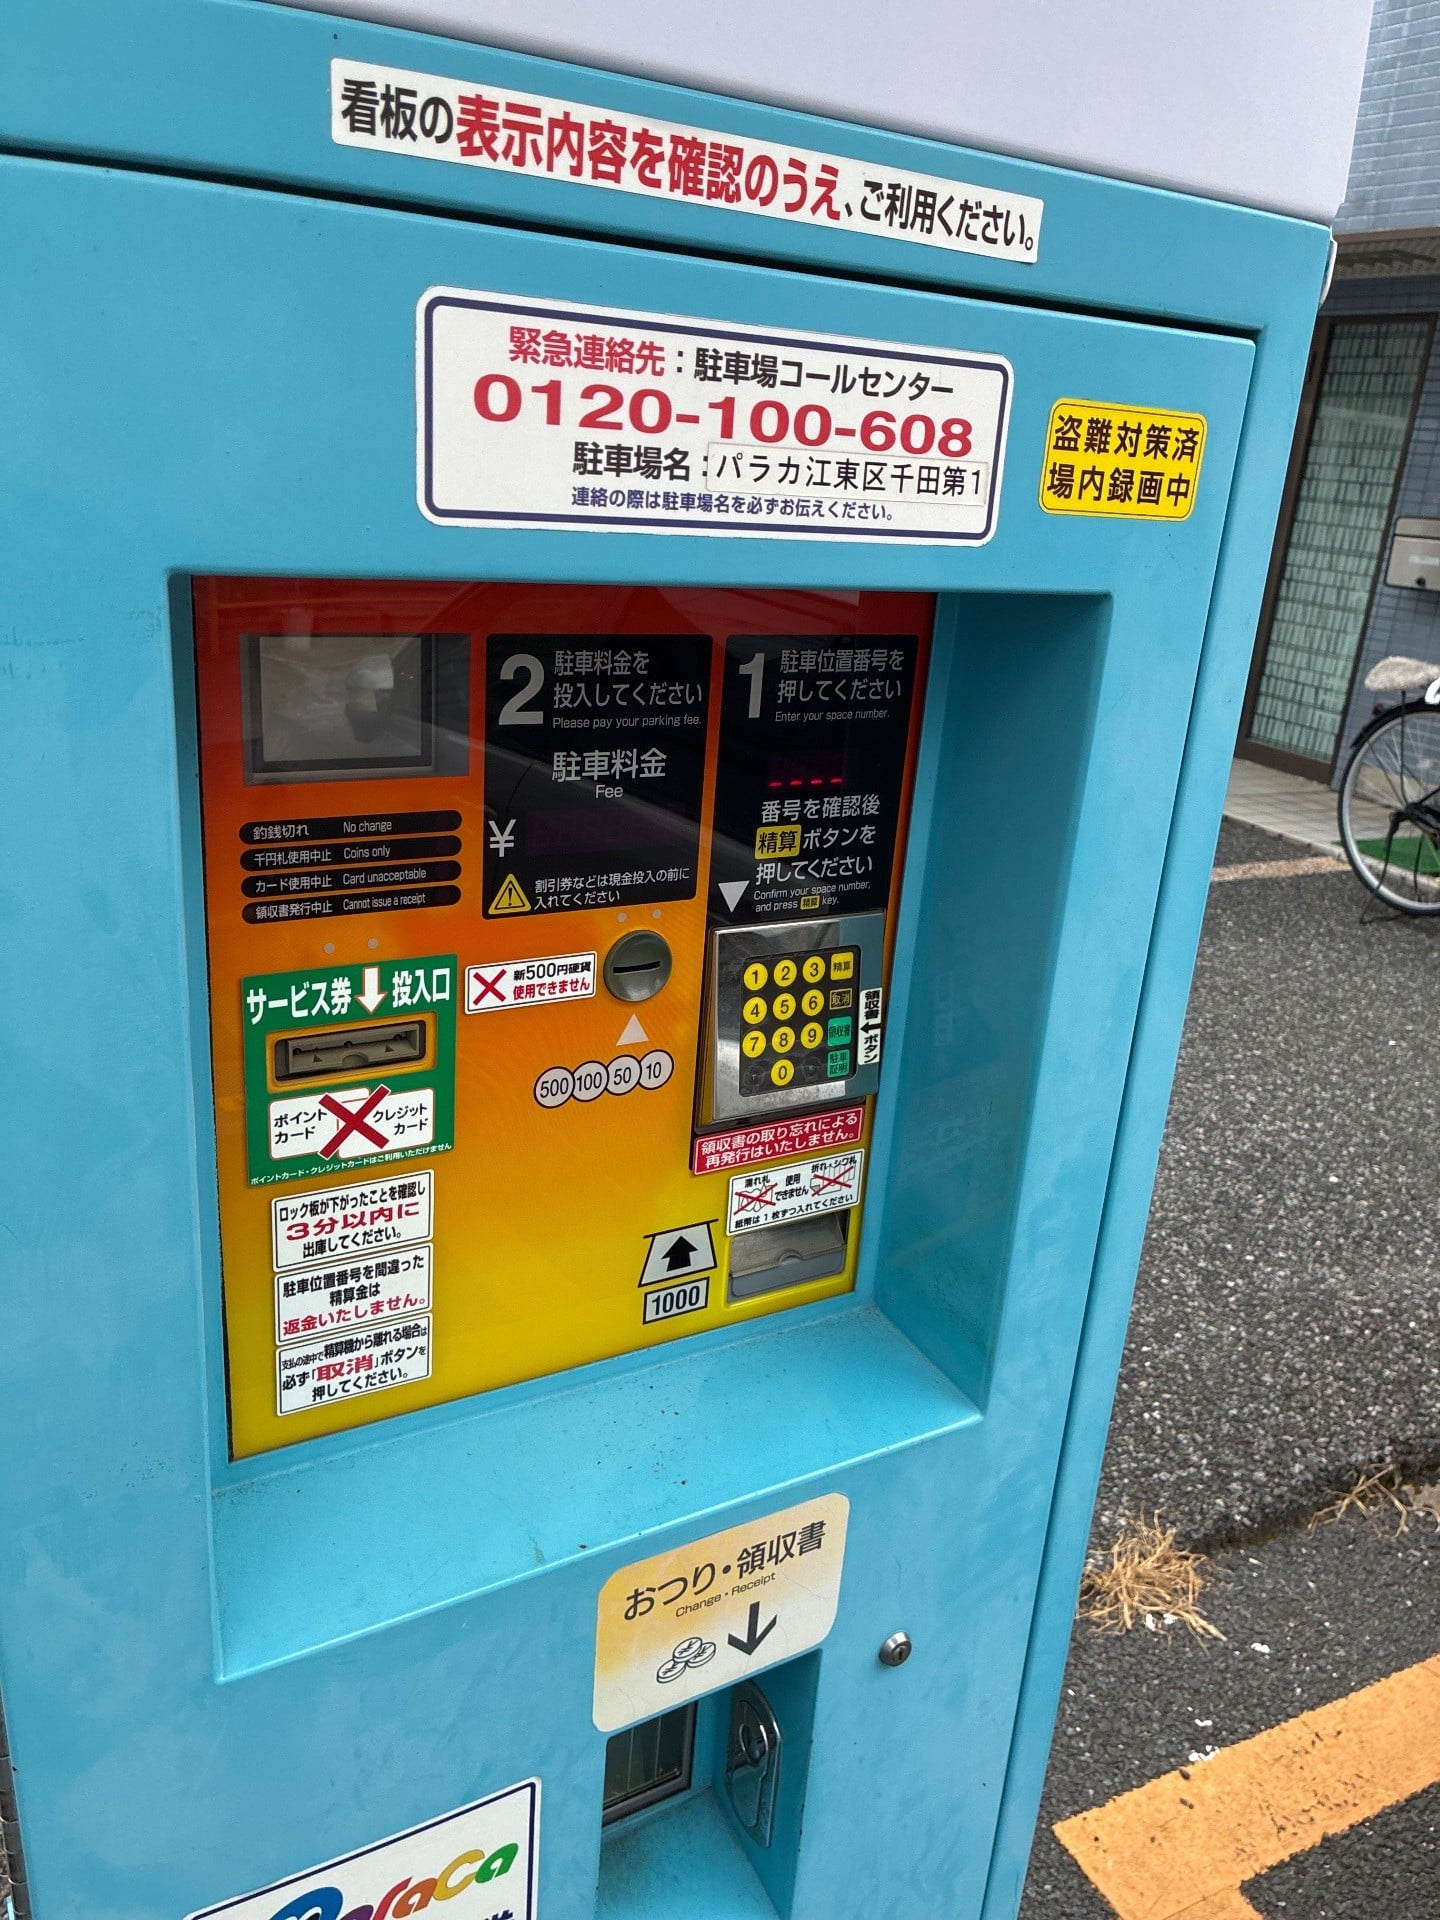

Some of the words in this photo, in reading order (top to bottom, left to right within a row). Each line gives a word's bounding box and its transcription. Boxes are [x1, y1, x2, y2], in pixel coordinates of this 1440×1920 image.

[341, 78, 1034, 251] 看板の表示内容を確認のうえ、ご利用ください。
[473, 374, 972, 457] 0120-100-608
[1053, 415, 1199, 462] 盗難対策済
[716, 453, 980, 496] パラカ江東区千田第1
[1047, 462, 1190, 506] 場内録画中
[571, 487, 893, 522] 連絡の際は駐車場名を必ずお伝えください。
[554, 650, 649, 676] 駐車料金を
[780, 649, 904, 674] 駐車位置番号を
[499, 654, 545, 725] 2
[553, 682, 702, 708] 投入してください
[738, 653, 766, 718] 1
[777, 678, 901, 705] 押してください
[553, 717, 589, 728] Please
[593, 718, 612, 729] pay
[616, 717, 639, 728] your
[642, 715, 680, 728] parking
[684, 714, 701, 725] fee.
[775, 711, 800, 722] Enter
[803, 712, 822, 724] your
[825, 712, 852, 723] space
[855, 709, 890, 720] number.
[552, 747, 667, 782] 駐車料金
[595, 784, 623, 799] Fee
[761, 794, 880, 824] 番号を確認後
[253, 824, 309, 841] 釣銭切れ
[343, 821, 356, 833] No
[359, 820, 392, 833] change
[489, 819, 516, 857] ¥
[253, 849, 332, 867] 千円札使用中止
[343, 847, 369, 859] Coins
[372, 845, 391, 859] only
[343, 873, 365, 885] Card
[368, 867, 426, 883] unacceptable
[535, 865, 689, 892] 割引券などは現金投入の前に
[756, 855, 872, 885] 押してください
[255, 875, 332, 893] カード使用中止
[754, 889, 787, 900] Confirm
[790, 887, 809, 898] your
[812, 884, 836, 896] space
[256, 900, 333, 920] 領収書発行中止
[343, 898, 371, 911] Cannot
[372, 896, 392, 909] issue
[394, 898, 399, 907] a
[400, 893, 426, 906] receipt
[534, 889, 620, 910] 入れてください
[755, 902, 771, 912] and
[774, 901, 798, 912] press
[822, 896, 839, 906] key.
[514, 961, 591, 981] 新500円硬貨
[752, 970, 759, 984] 1
[781, 966, 791, 980] 2
[810, 963, 819, 977] 3
[247, 976, 351, 1025] サービス券
[392, 968, 451, 1008] 投入口
[513, 977, 590, 1000] 使用できません
[751, 1003, 760, 1018] 4
[780, 1000, 789, 1014] 5
[808, 996, 818, 1010] 6
[864, 991, 880, 1020] 領収書
[750, 1037, 759, 1052] 7
[779, 1033, 788, 1048] 8
[807, 1029, 817, 1043] 9
[864, 1034, 878, 1063] ボタン
[540, 1077, 569, 1098] 500
[576, 1071, 602, 1092] 100
[613, 1066, 632, 1086] 50
[646, 1062, 662, 1080] 10
[778, 1065, 788, 1080] 0
[274, 1109, 328, 1129] ポイント
[373, 1103, 427, 1124] クレジット
[394, 1118, 428, 1136] カード
[275, 1126, 316, 1145] カード
[702, 1112, 857, 1155] 領収書の取り忘れによる
[705, 1130, 855, 1168] 再発行はいたしません。
[250, 1143, 452, 1185] ポイントカード・クレジットカードはご利用いただけません
[775, 1185, 809, 1201] できません
[785, 1173, 801, 1186] 使用
[279, 1181, 426, 1223] ロック板が下がったことを確認し
[286, 1201, 420, 1241] 3分以内に
[303, 1226, 402, 1259] 出庫してください。
[283, 1254, 425, 1298] 駐車位置番号を間違った
[329, 1282, 381, 1307] 精算金は
[652, 1285, 700, 1316] 1000
[283, 1293, 426, 1337] 返金いたしません。
[282, 1345, 426, 1391] 必ず「取消」ボタンを
[312, 1367, 408, 1402] 押してください。
[623, 1521, 826, 1621] おつり・領収書
[676, 1594, 721, 1617] Change
[731, 1572, 776, 1596] Receipt
